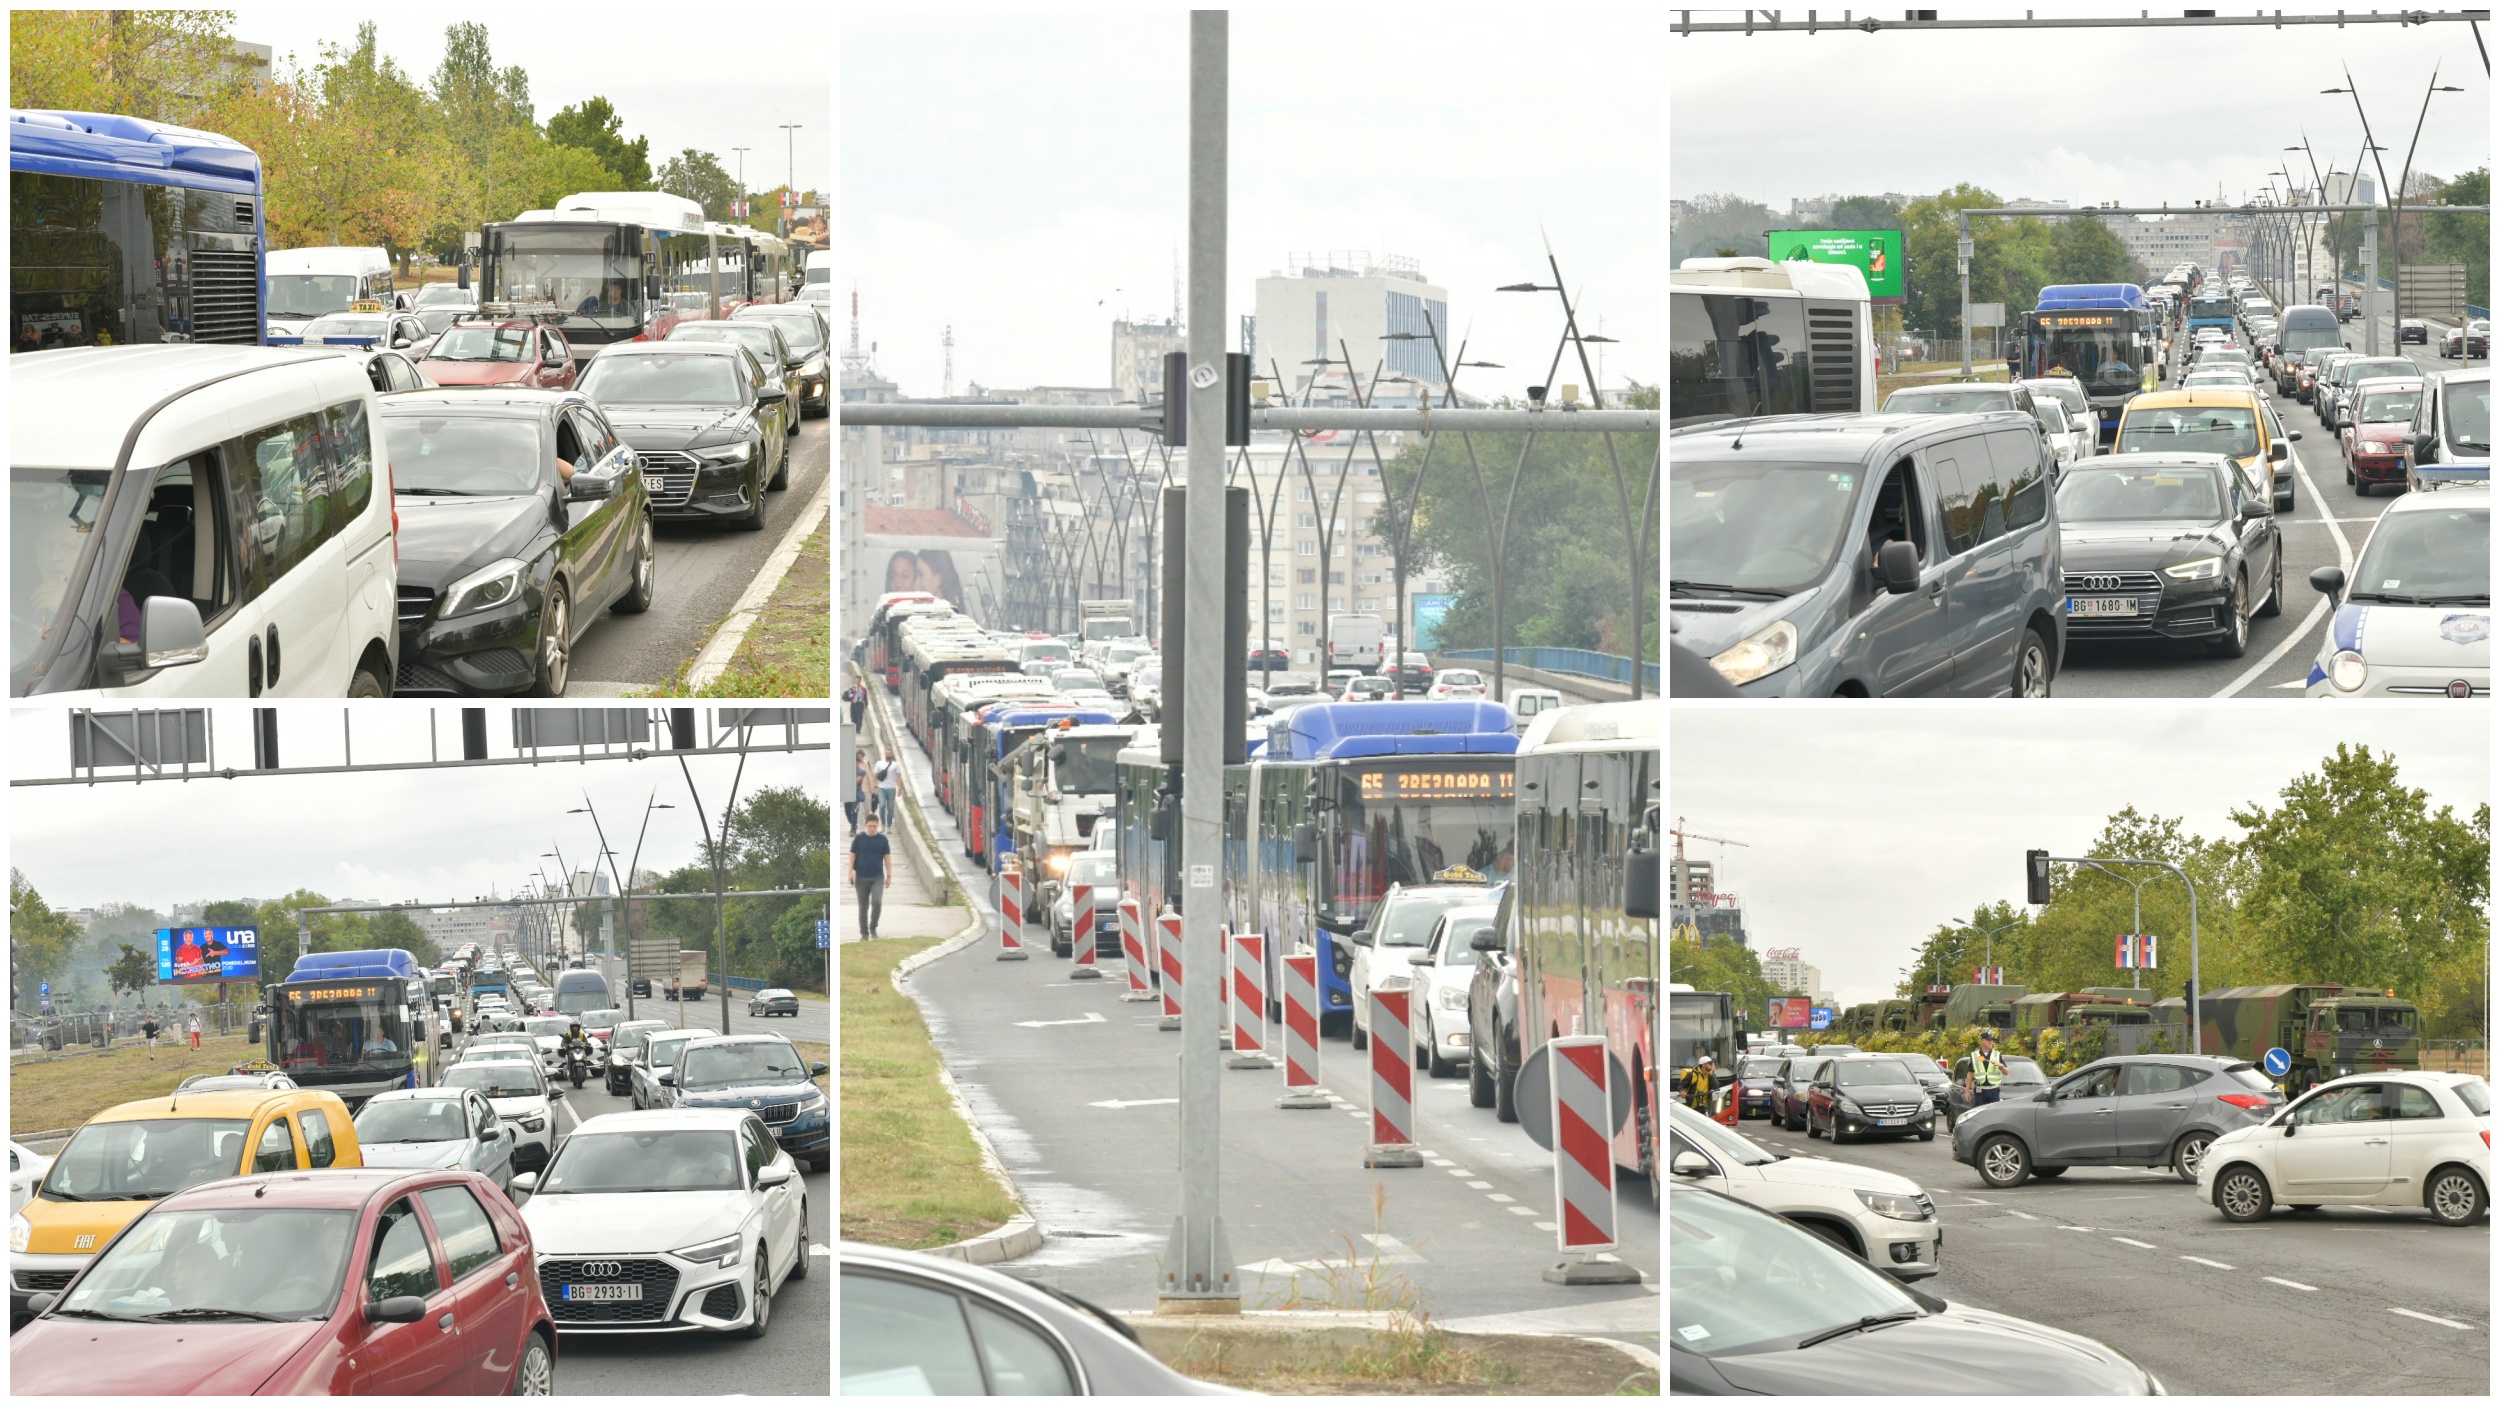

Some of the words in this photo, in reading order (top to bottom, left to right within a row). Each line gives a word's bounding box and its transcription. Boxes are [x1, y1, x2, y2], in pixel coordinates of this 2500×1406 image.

[358, 303, 376, 311] TAXI
[2073, 600, 2086, 612] BG
[2453, 687, 2466, 698] FIAT
[1361, 773, 1384, 798] 65
[1443, 871, 1463, 879] Gold
[226, 930, 255, 945] una
[73, 1234, 97, 1249] FIAT
[571, 1286, 585, 1299] BG
